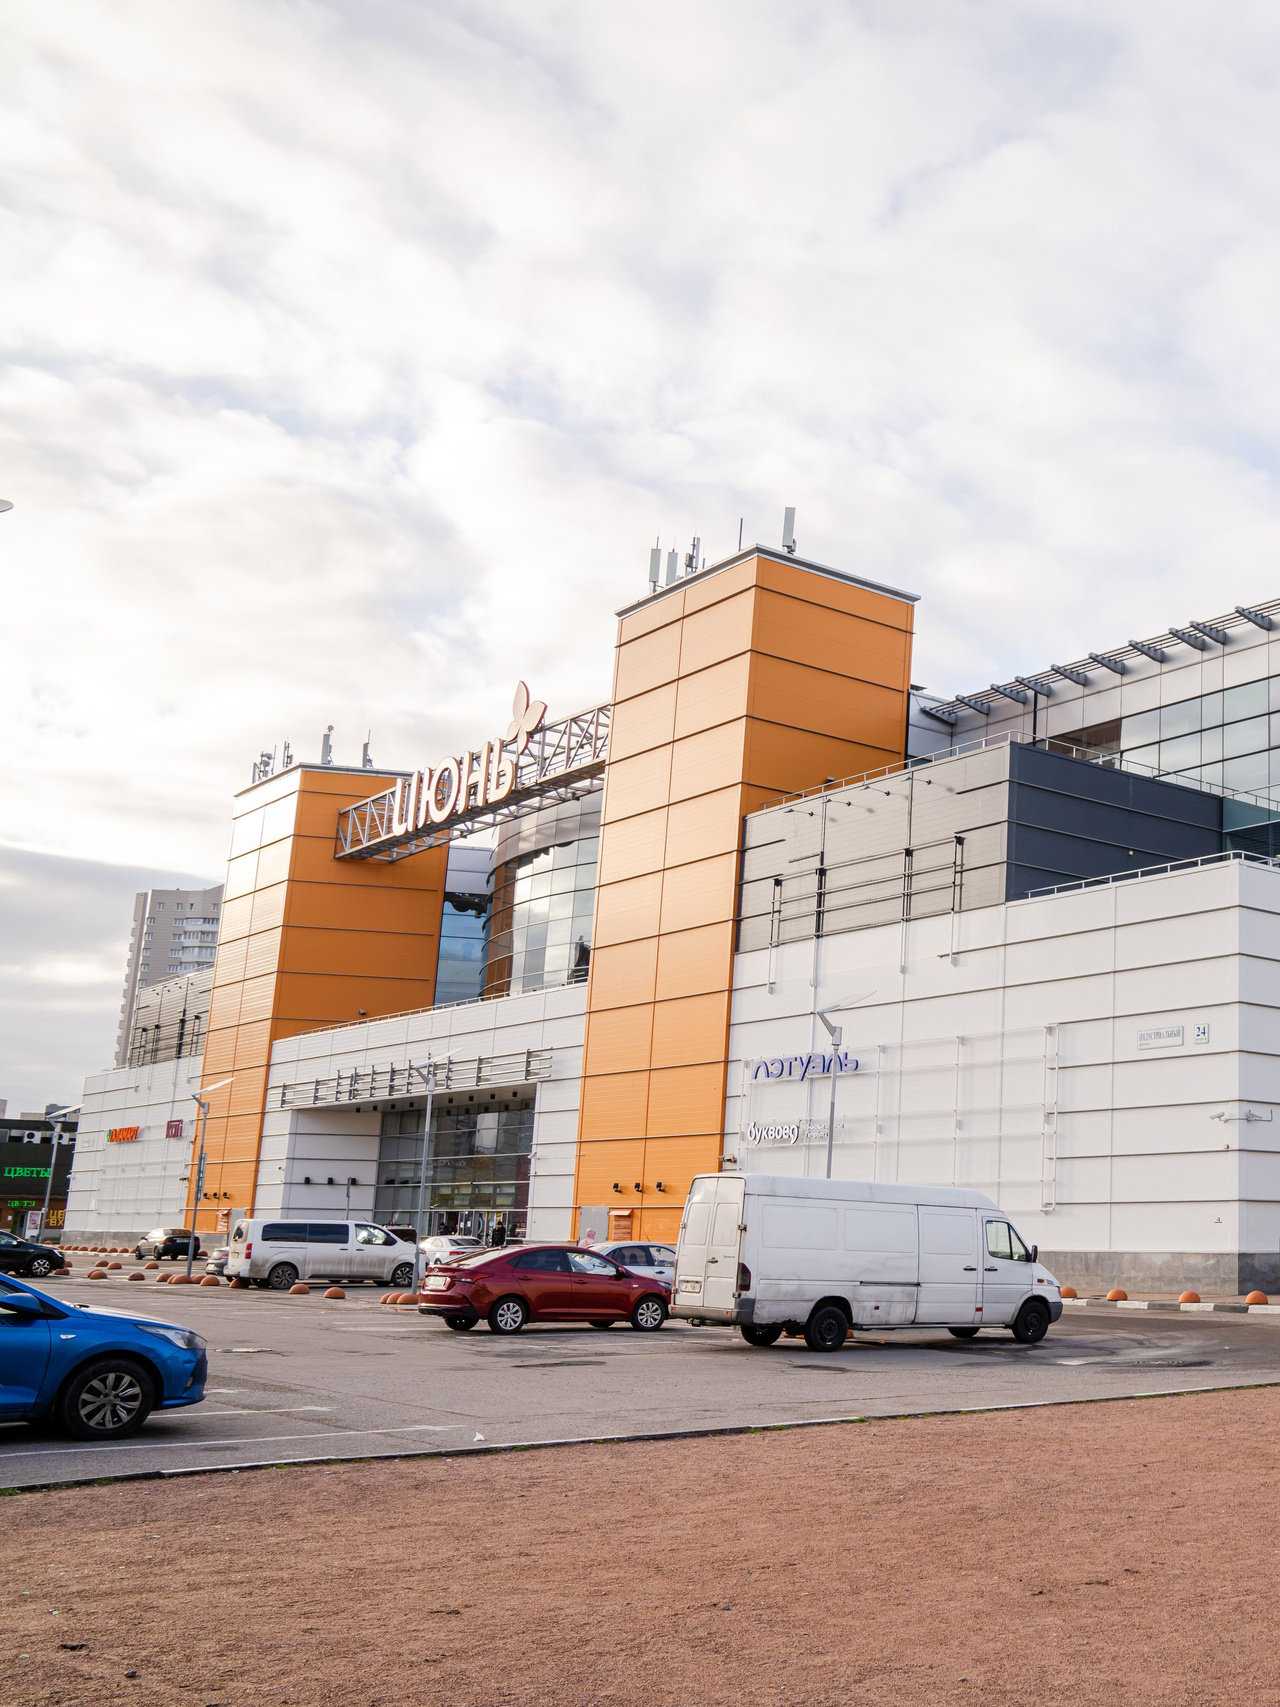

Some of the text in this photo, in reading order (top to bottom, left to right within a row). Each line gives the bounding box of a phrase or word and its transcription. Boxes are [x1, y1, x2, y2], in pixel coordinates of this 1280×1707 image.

[392, 737, 515, 836] ИЮНЬ
[1196, 1026, 1206, 1037] 24
[4, 1166, 51, 1178] ЦВЕТЫ
